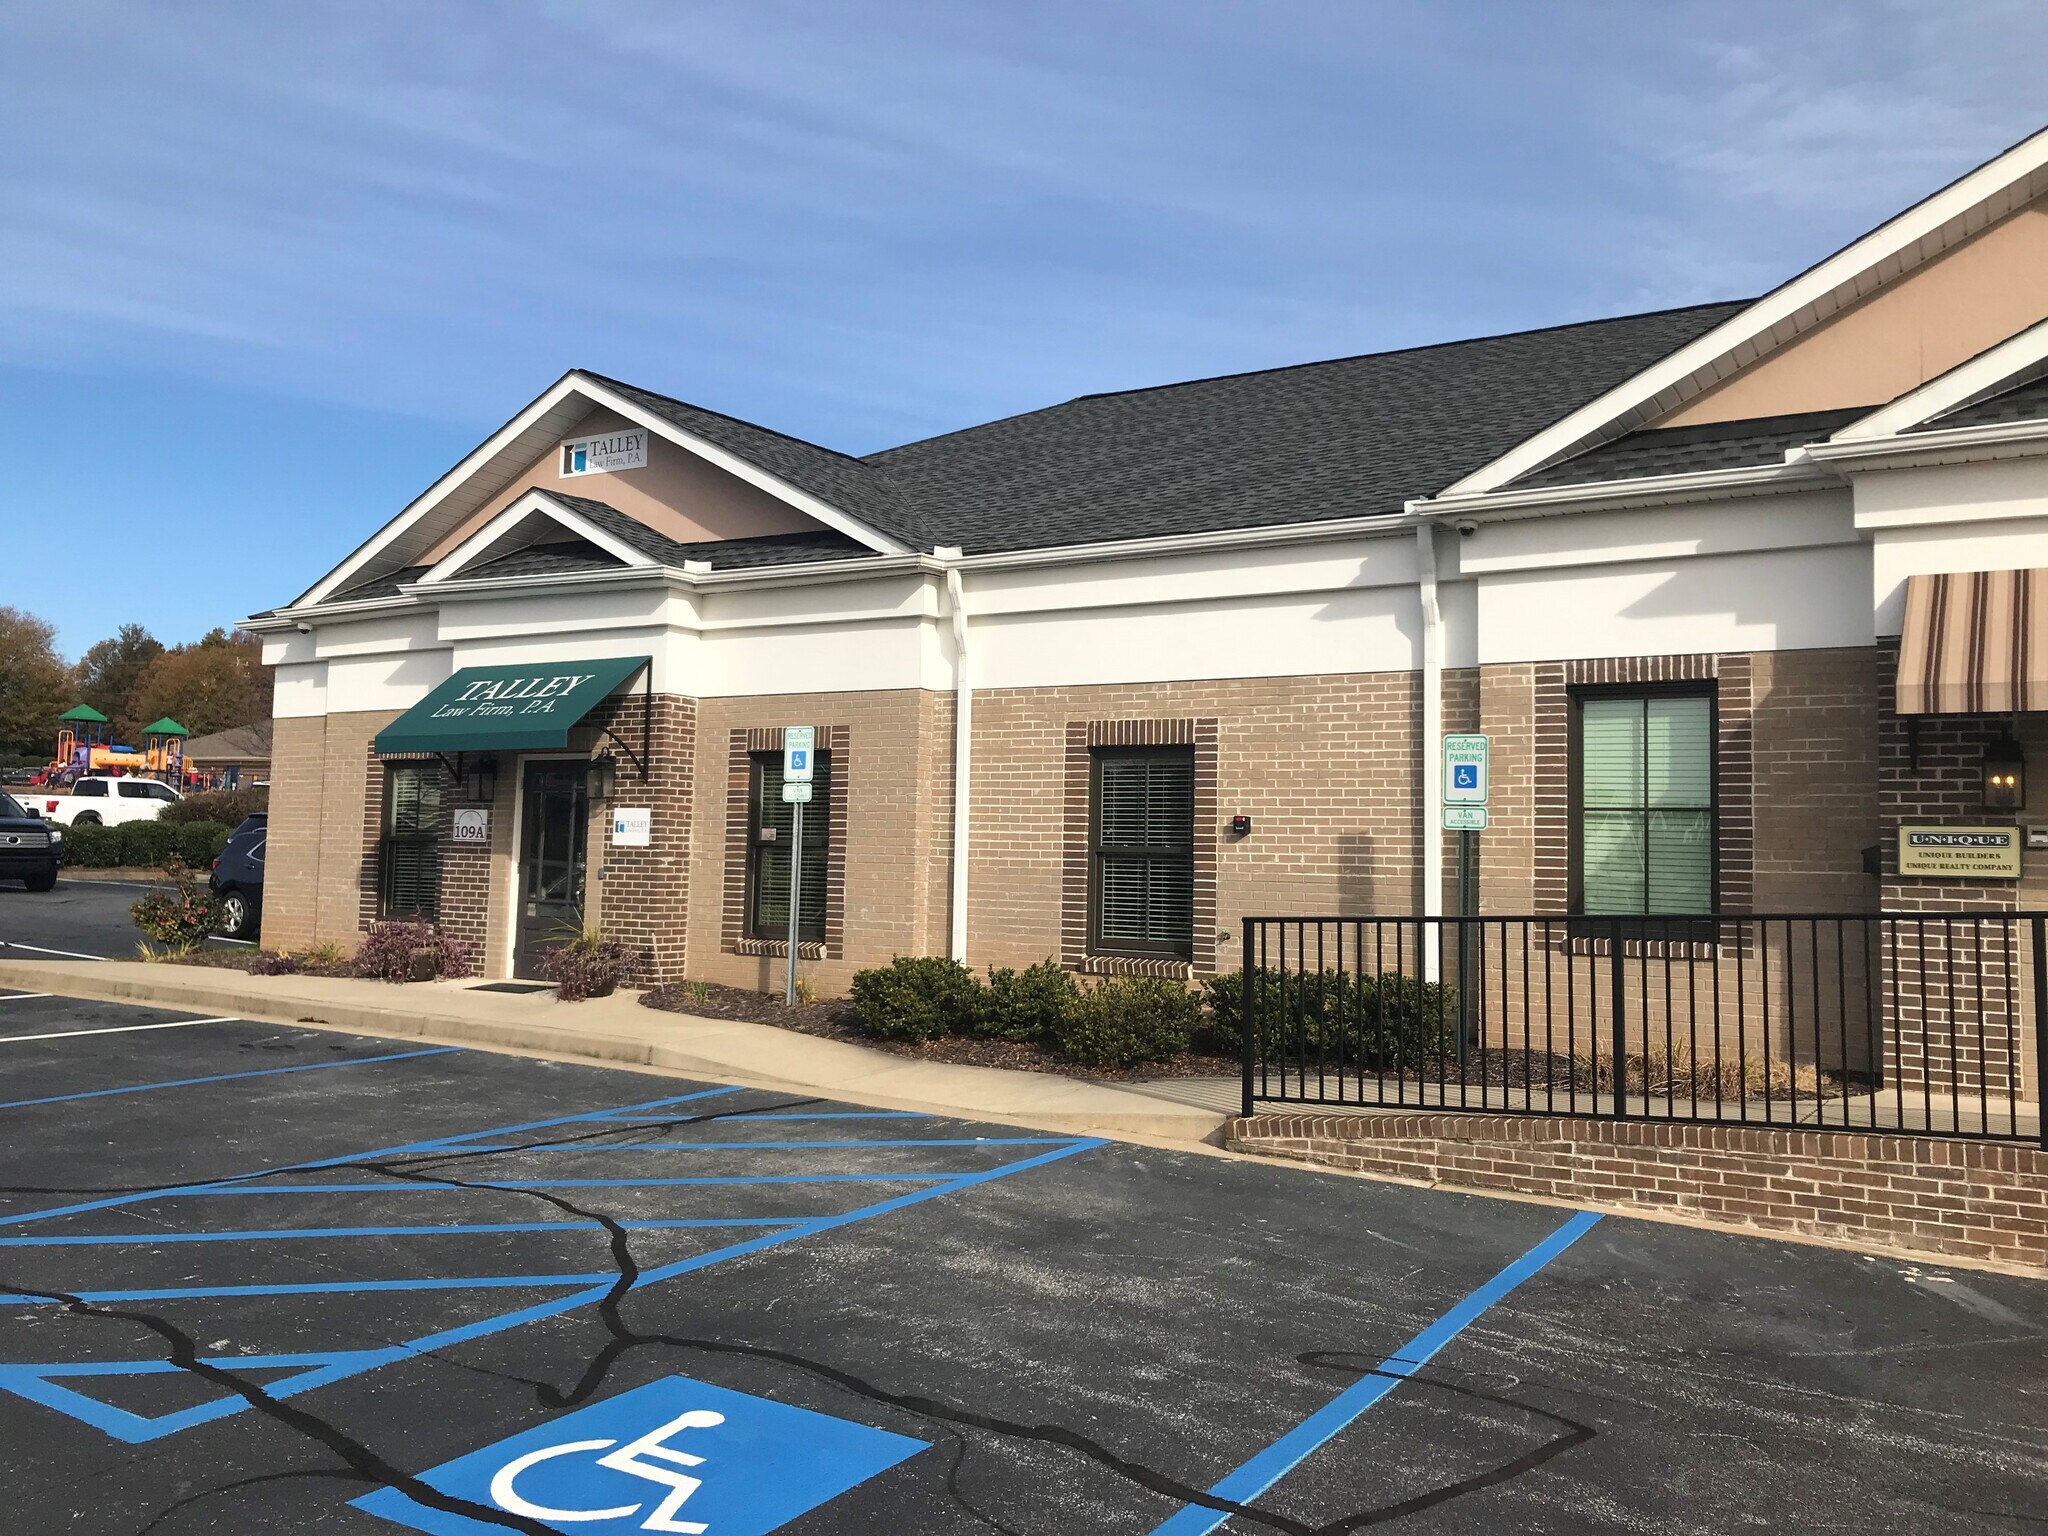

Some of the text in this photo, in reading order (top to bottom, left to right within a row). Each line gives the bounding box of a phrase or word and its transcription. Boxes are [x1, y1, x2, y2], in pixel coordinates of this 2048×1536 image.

[590, 434, 643, 456] TALLEY
[589, 458, 604, 469] Law
[455, 674, 596, 701] TALLEY
[430, 699, 555, 718] Law Firm, P.A.
[1447, 742, 1486, 751] RESERVED
[1449, 753, 1483, 762] PARKING
[455, 825, 484, 838] 109A
